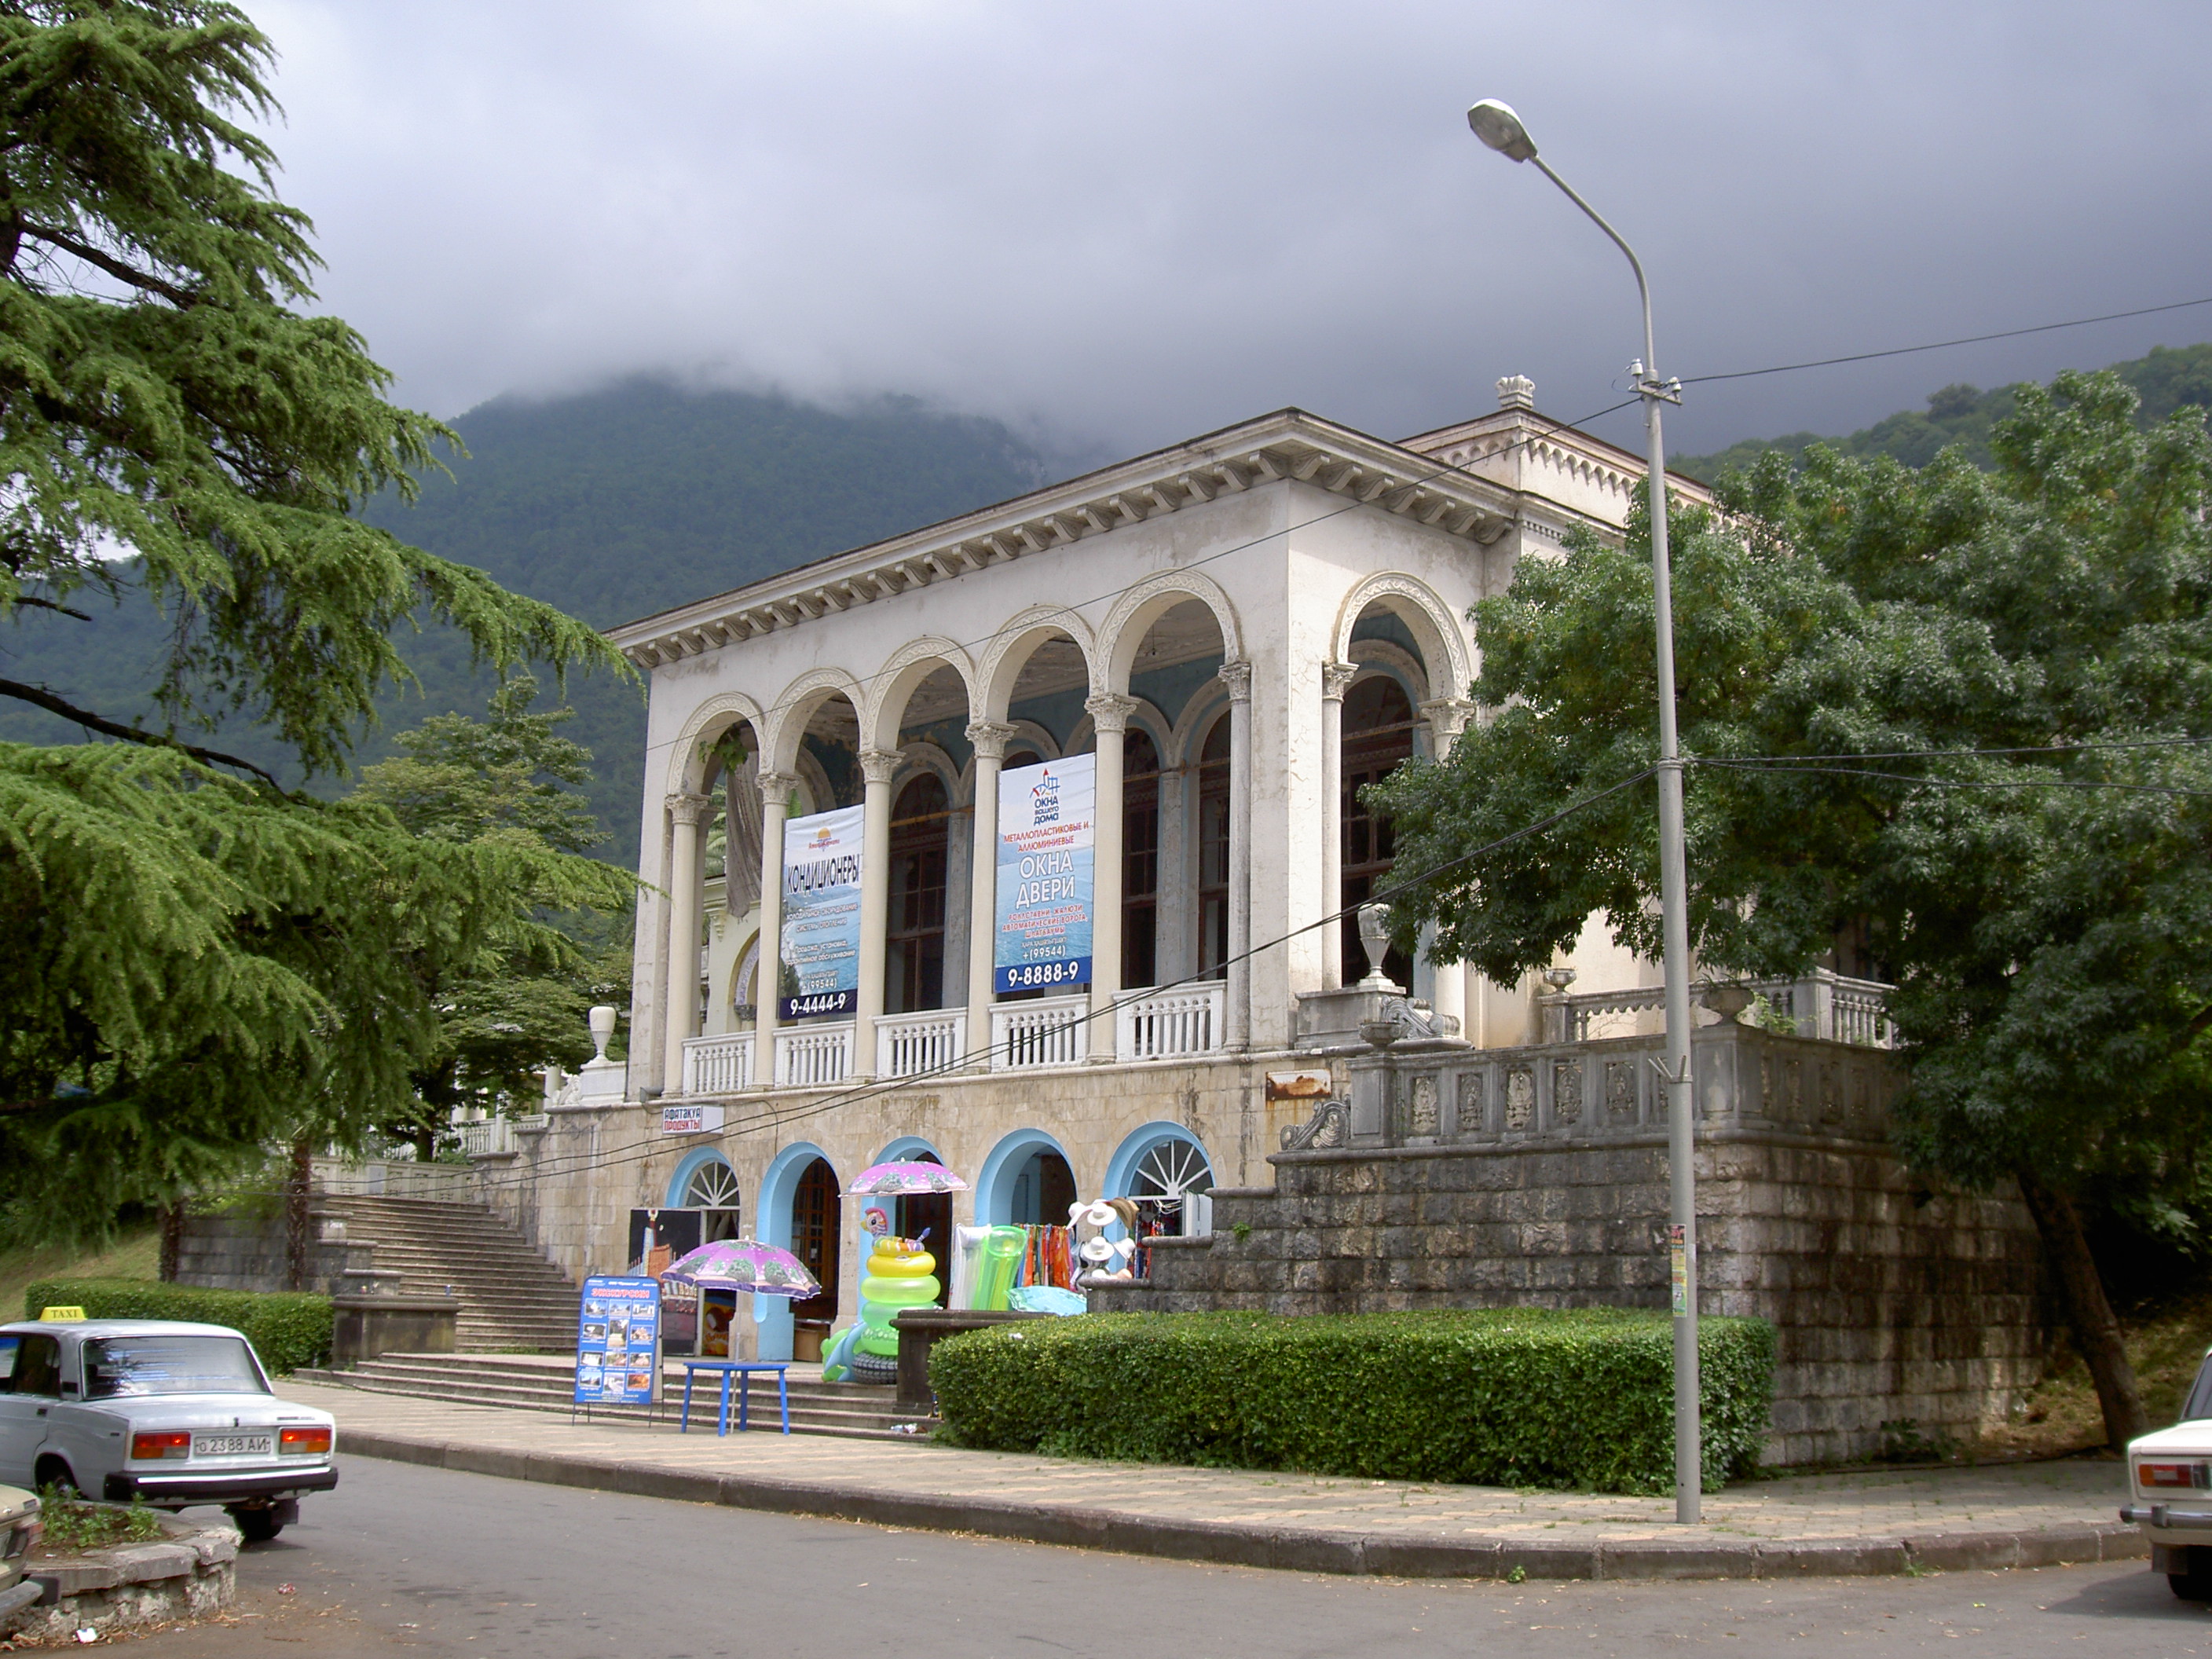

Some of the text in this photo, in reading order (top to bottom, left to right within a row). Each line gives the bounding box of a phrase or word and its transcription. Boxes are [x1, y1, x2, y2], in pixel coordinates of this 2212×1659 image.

[1035, 796, 1059, 808] ОКНА
[1004, 821, 1090, 843] МЕТАЛЛОПЛАСТИКОВЫЕ И
[1018, 835, 1075, 852] АЛЛЮМИНИЕВЫЕ
[1020, 849, 1074, 879] ОКНА
[787, 854, 860, 895] КОНДИЦИОНЕРЫ
[1016, 875, 1075, 910] ДВЕРИ
[1002, 917, 1059, 932] АВТОМАТИЧЕСКИЕ
[1023, 945, 1066, 961] +(99544)
[1008, 961, 1079, 987] 9-8888-9
[790, 993, 847, 1015] 9-4444-9
[665, 1119, 701, 1131] ПРОДУКТЫ
[51, 1309, 77, 1319] TAXI
[210, 1438, 244, 1452] 2388
